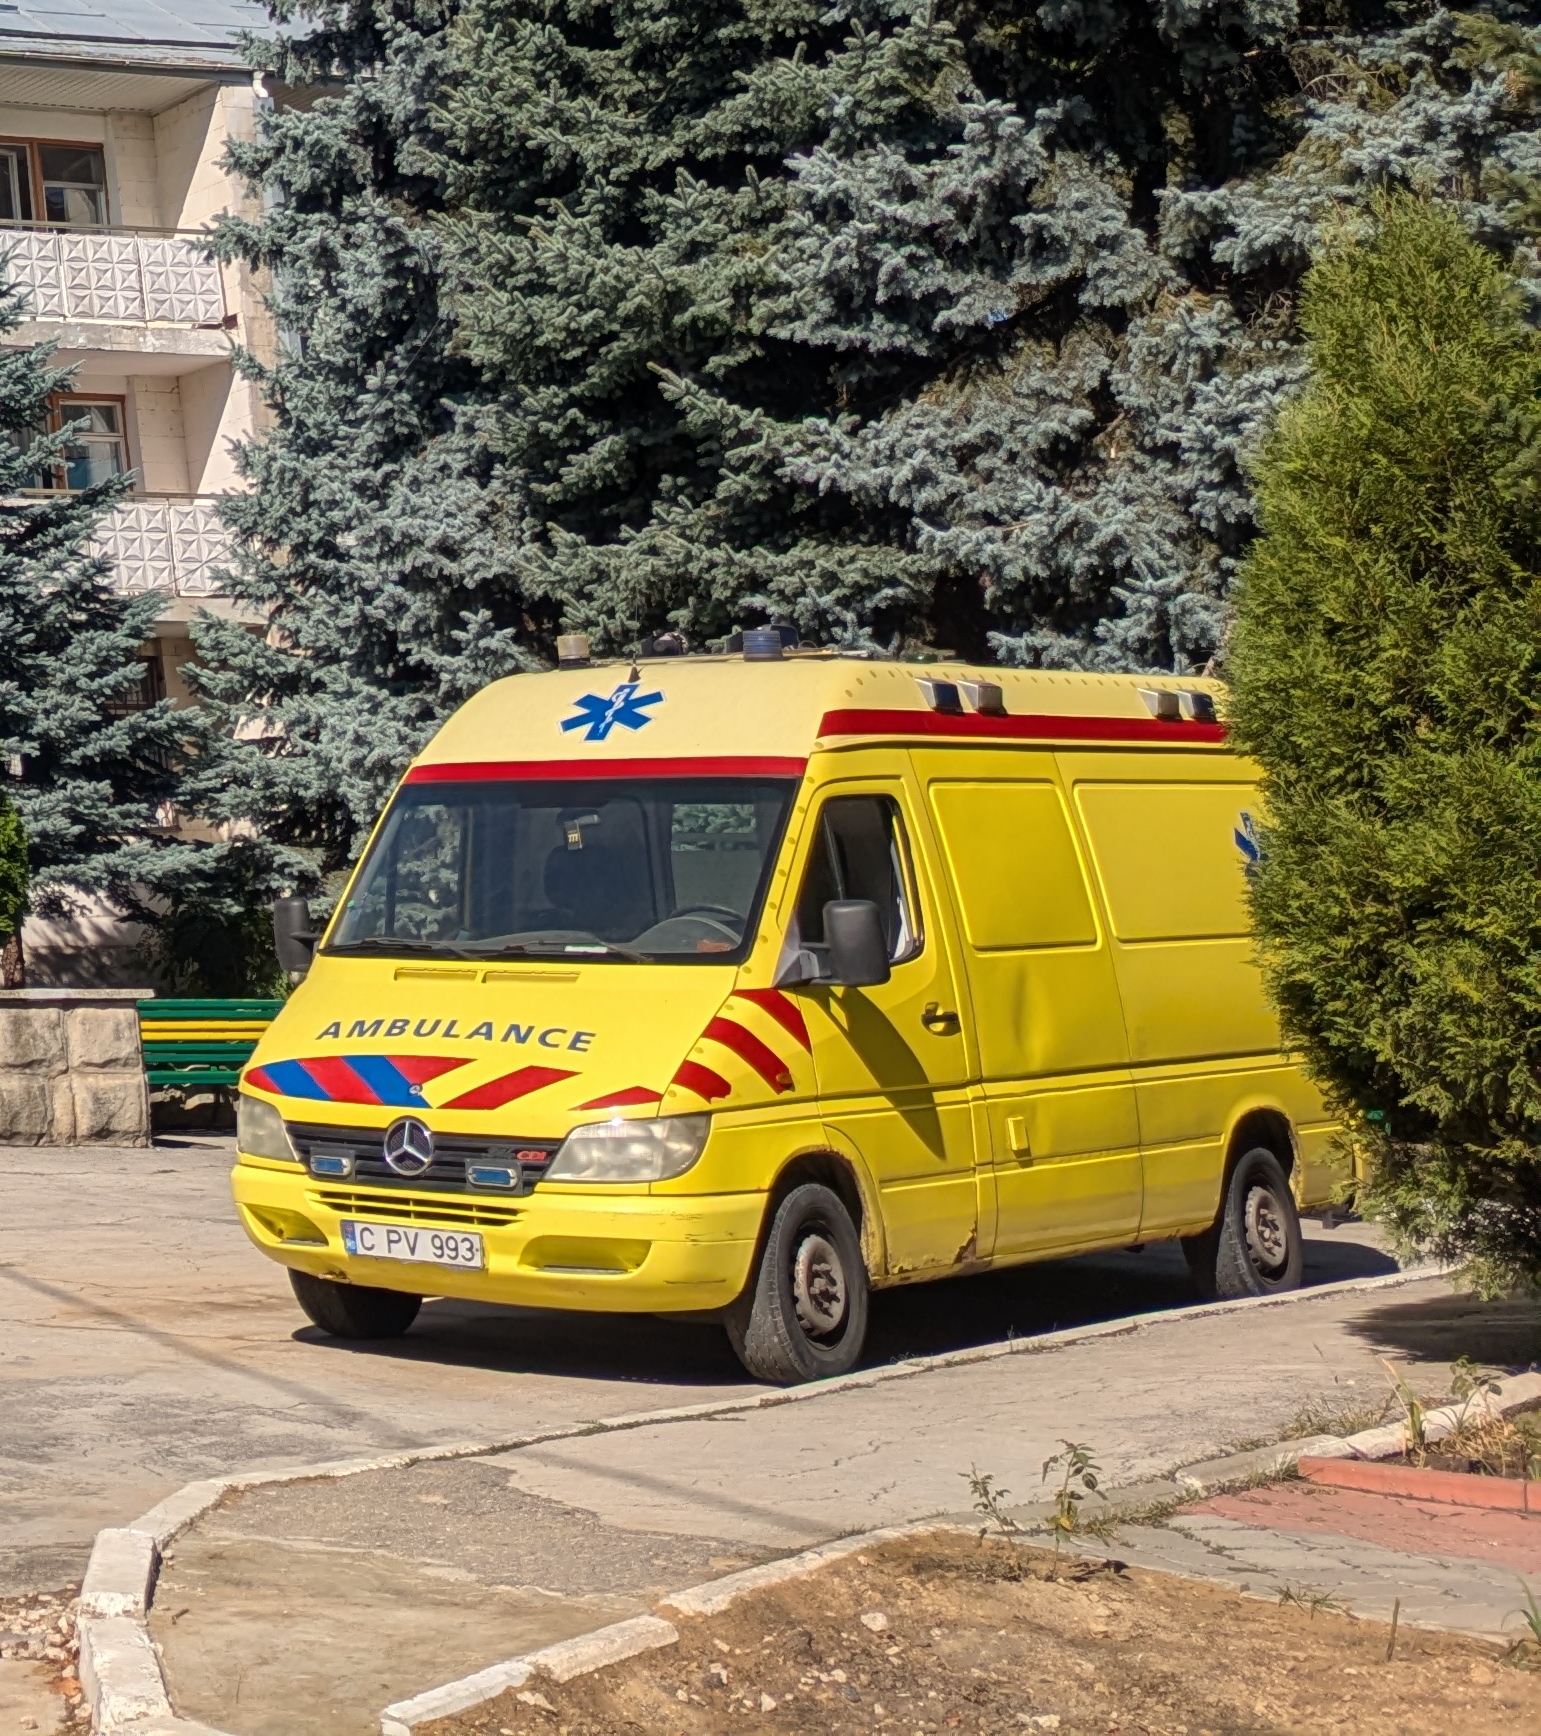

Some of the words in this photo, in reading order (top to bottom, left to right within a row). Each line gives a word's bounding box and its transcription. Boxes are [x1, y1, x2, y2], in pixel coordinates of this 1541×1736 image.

[315, 1018, 597, 1053] AMBULANCE
[516, 1150, 547, 1161] CDI
[359, 1226, 376, 1252] C
[386, 1228, 419, 1257] PV
[430, 1233, 475, 1263] 993
